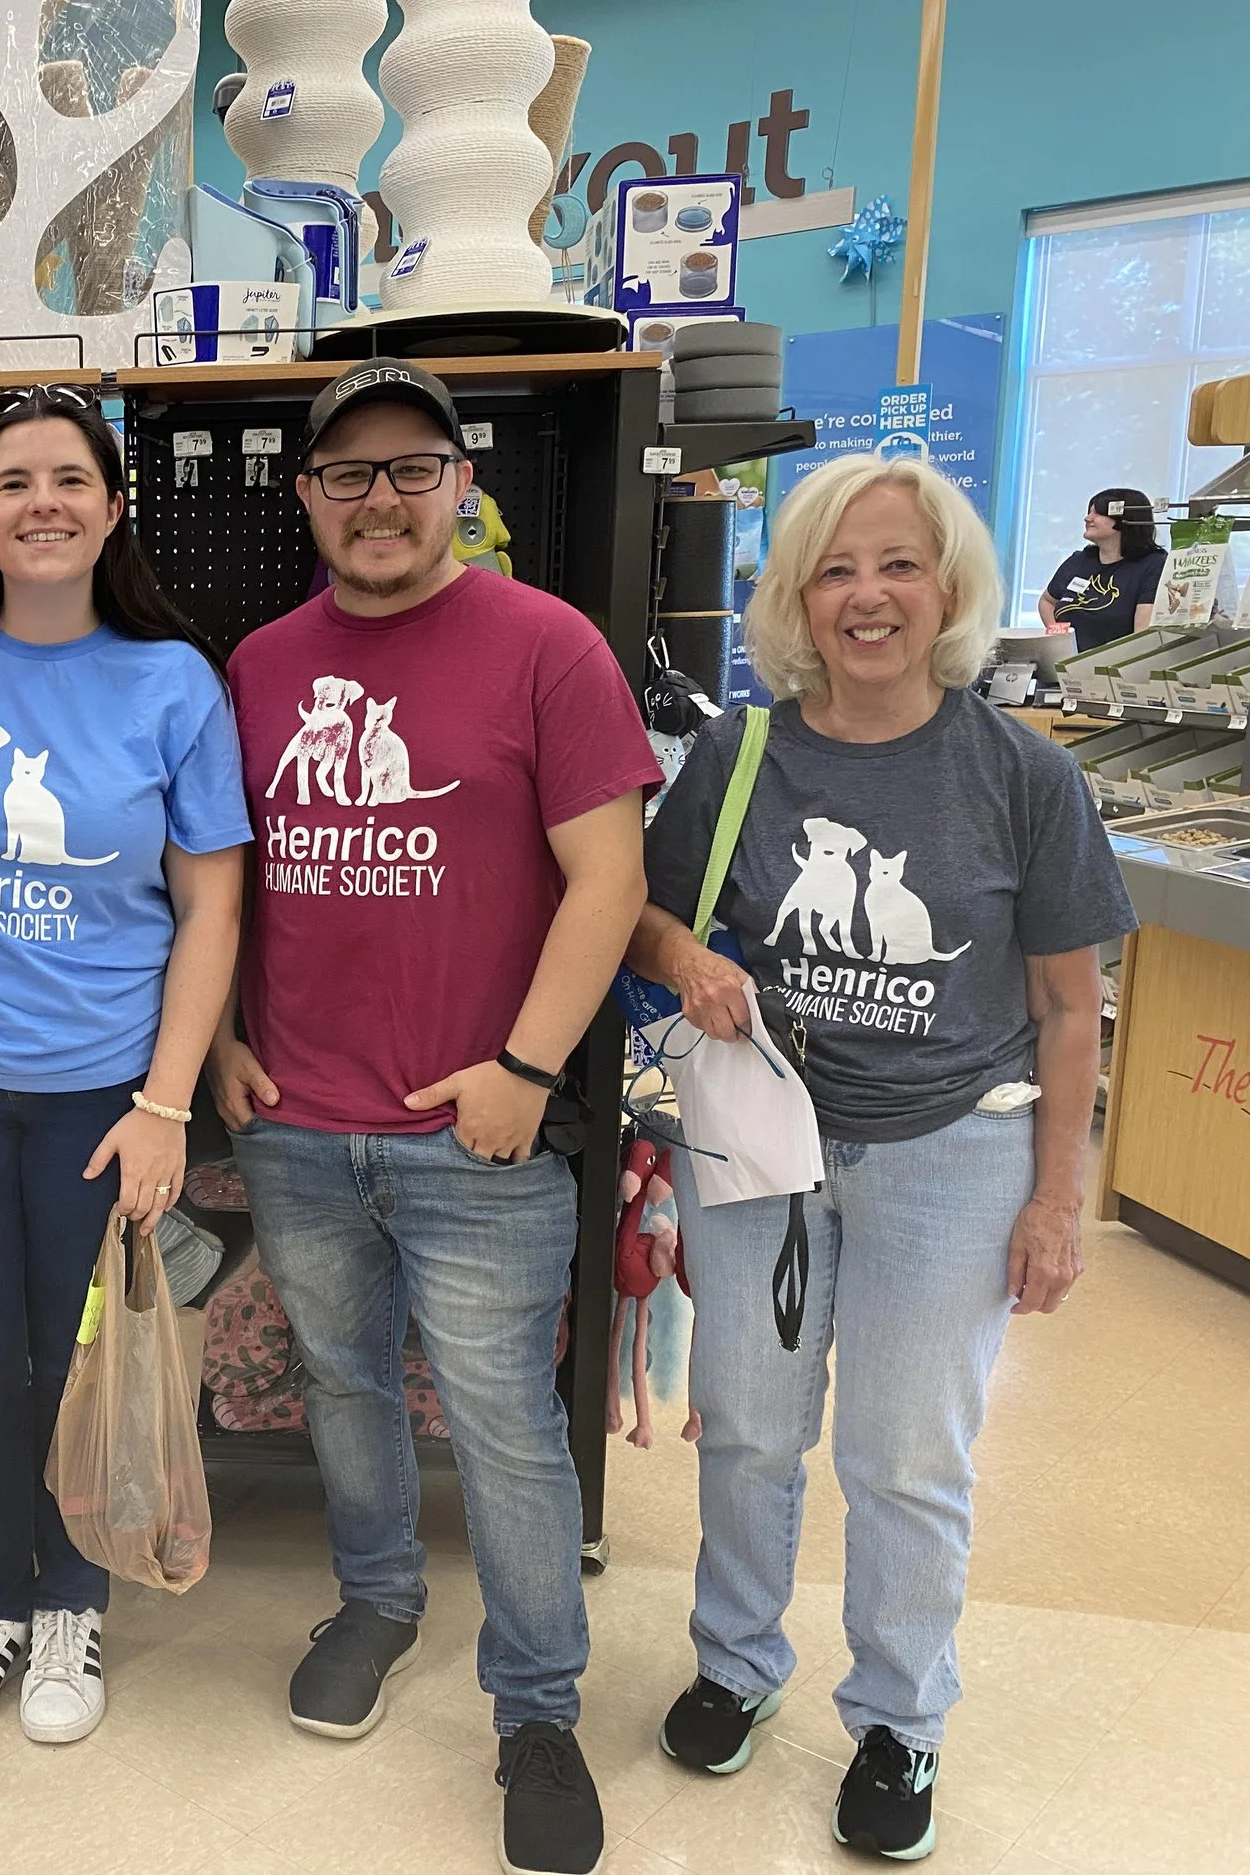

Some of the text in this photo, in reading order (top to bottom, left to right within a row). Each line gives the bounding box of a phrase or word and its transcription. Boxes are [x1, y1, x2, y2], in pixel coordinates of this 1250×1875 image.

[881, 392, 927, 406] ORDER
[880, 404, 907, 416] PICK
[911, 403, 927, 414] UP
[814, 414, 846, 430] e're
[879, 414, 927, 430] HERE
[829, 437, 874, 451] making
[938, 450, 975, 463] world
[265, 815, 438, 862] Henrico
[265, 862, 446, 897] HUMANE SOCIETY
[780, 957, 935, 1008] Henrico
[848, 1001, 937, 1037] SOCIETY
[1192, 1034, 1250, 1104] The
